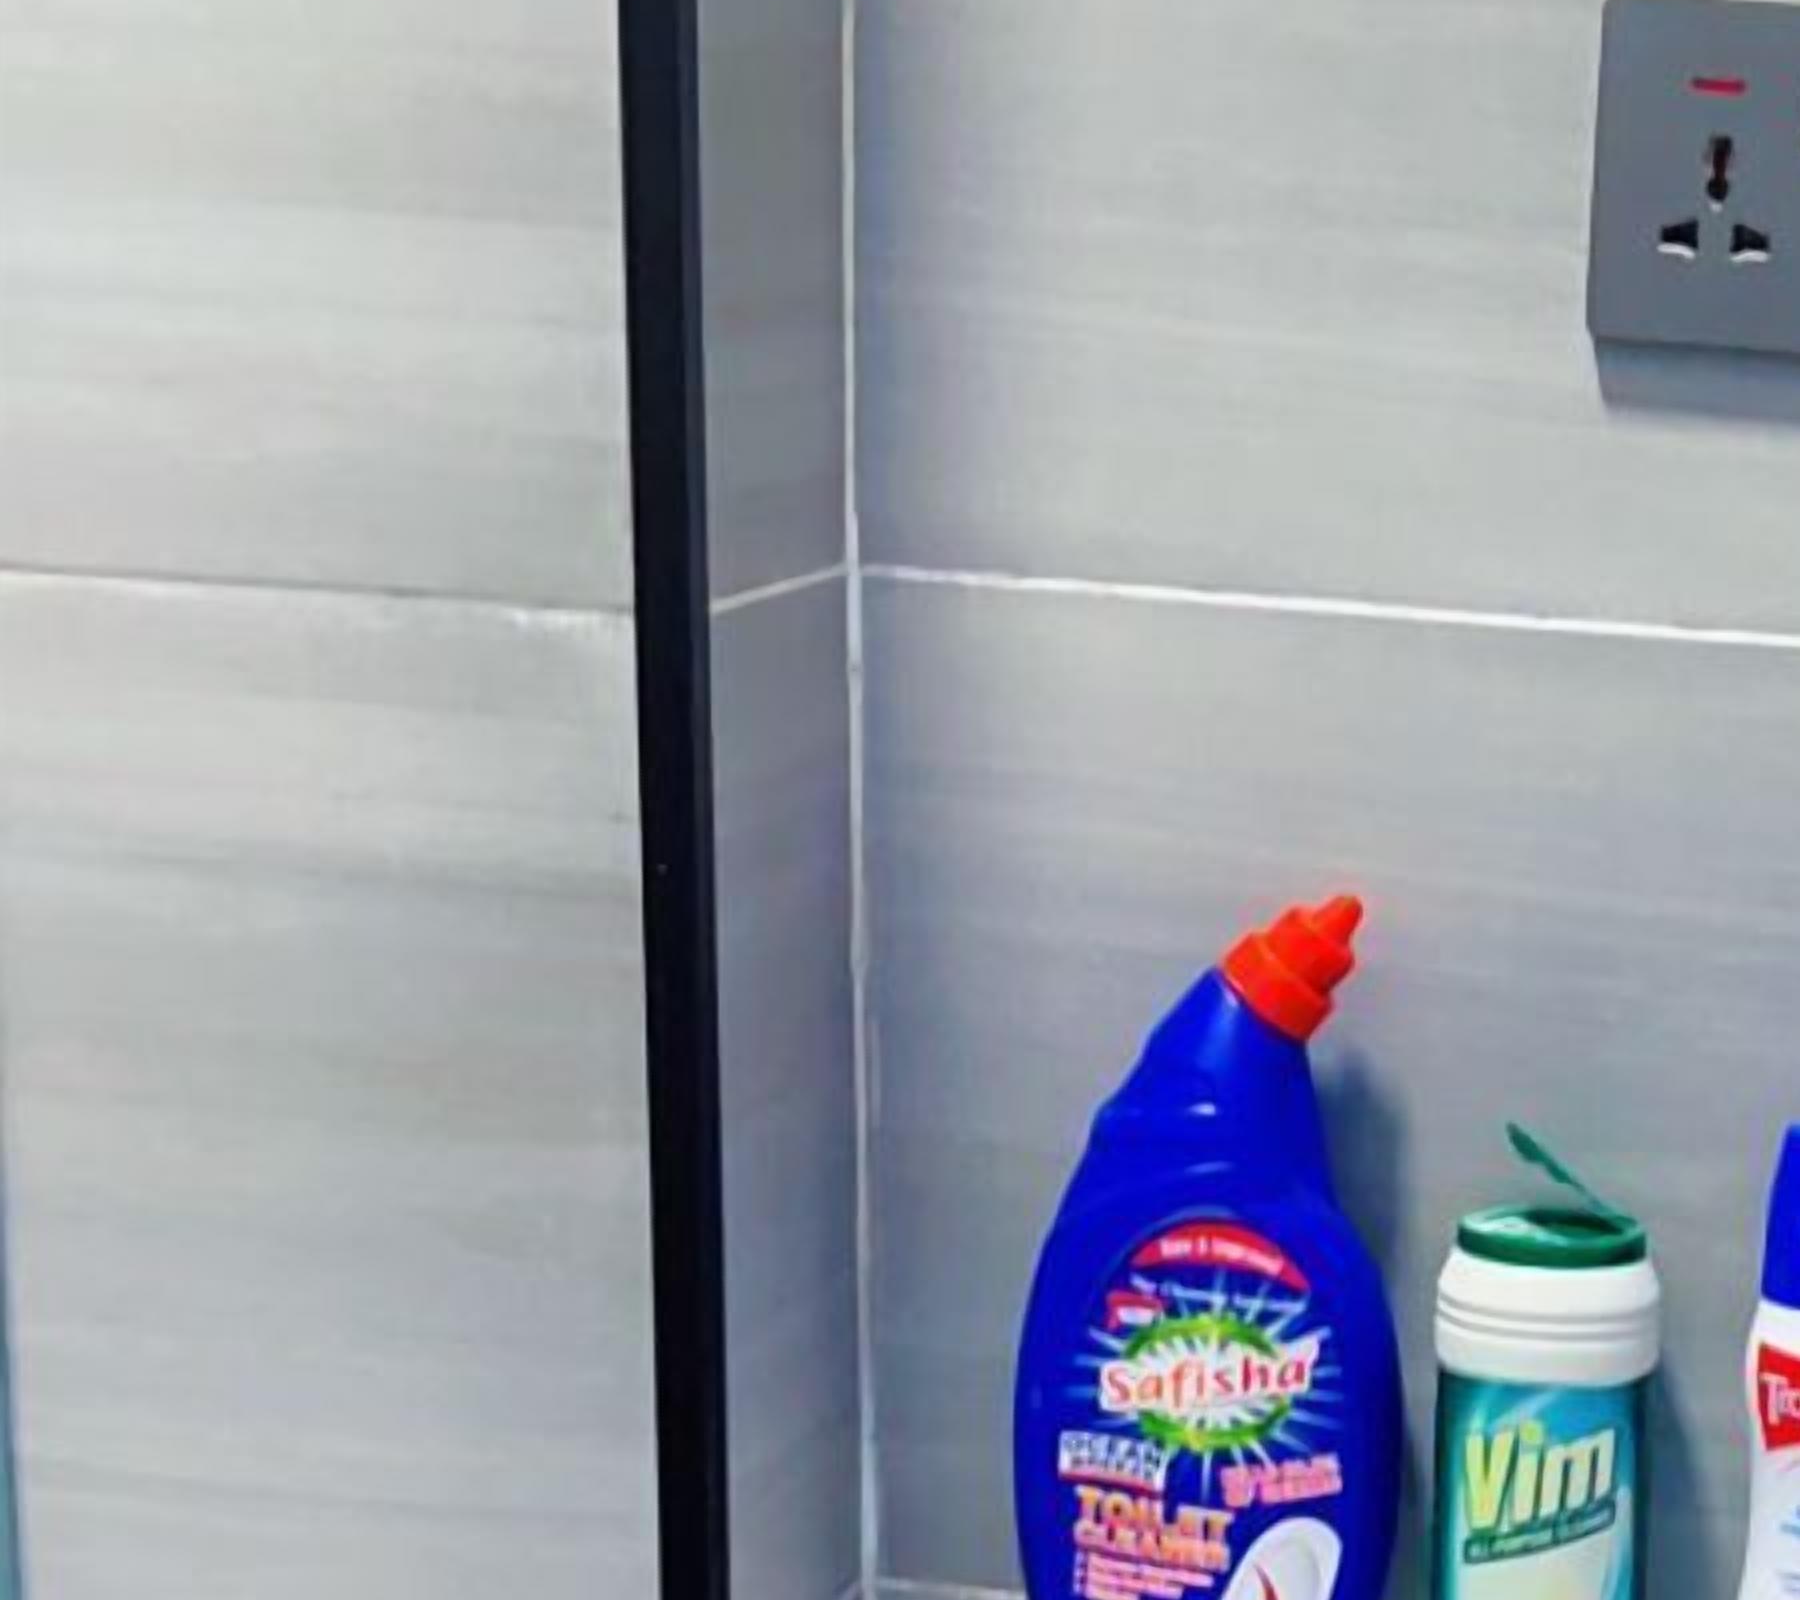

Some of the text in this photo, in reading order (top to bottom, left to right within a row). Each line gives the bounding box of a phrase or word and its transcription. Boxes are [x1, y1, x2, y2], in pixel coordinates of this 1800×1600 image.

[1107, 1354, 1308, 1409] Safisha
[1465, 1417, 1616, 1529] Vim
[1074, 1483, 1236, 1542] TOILET
